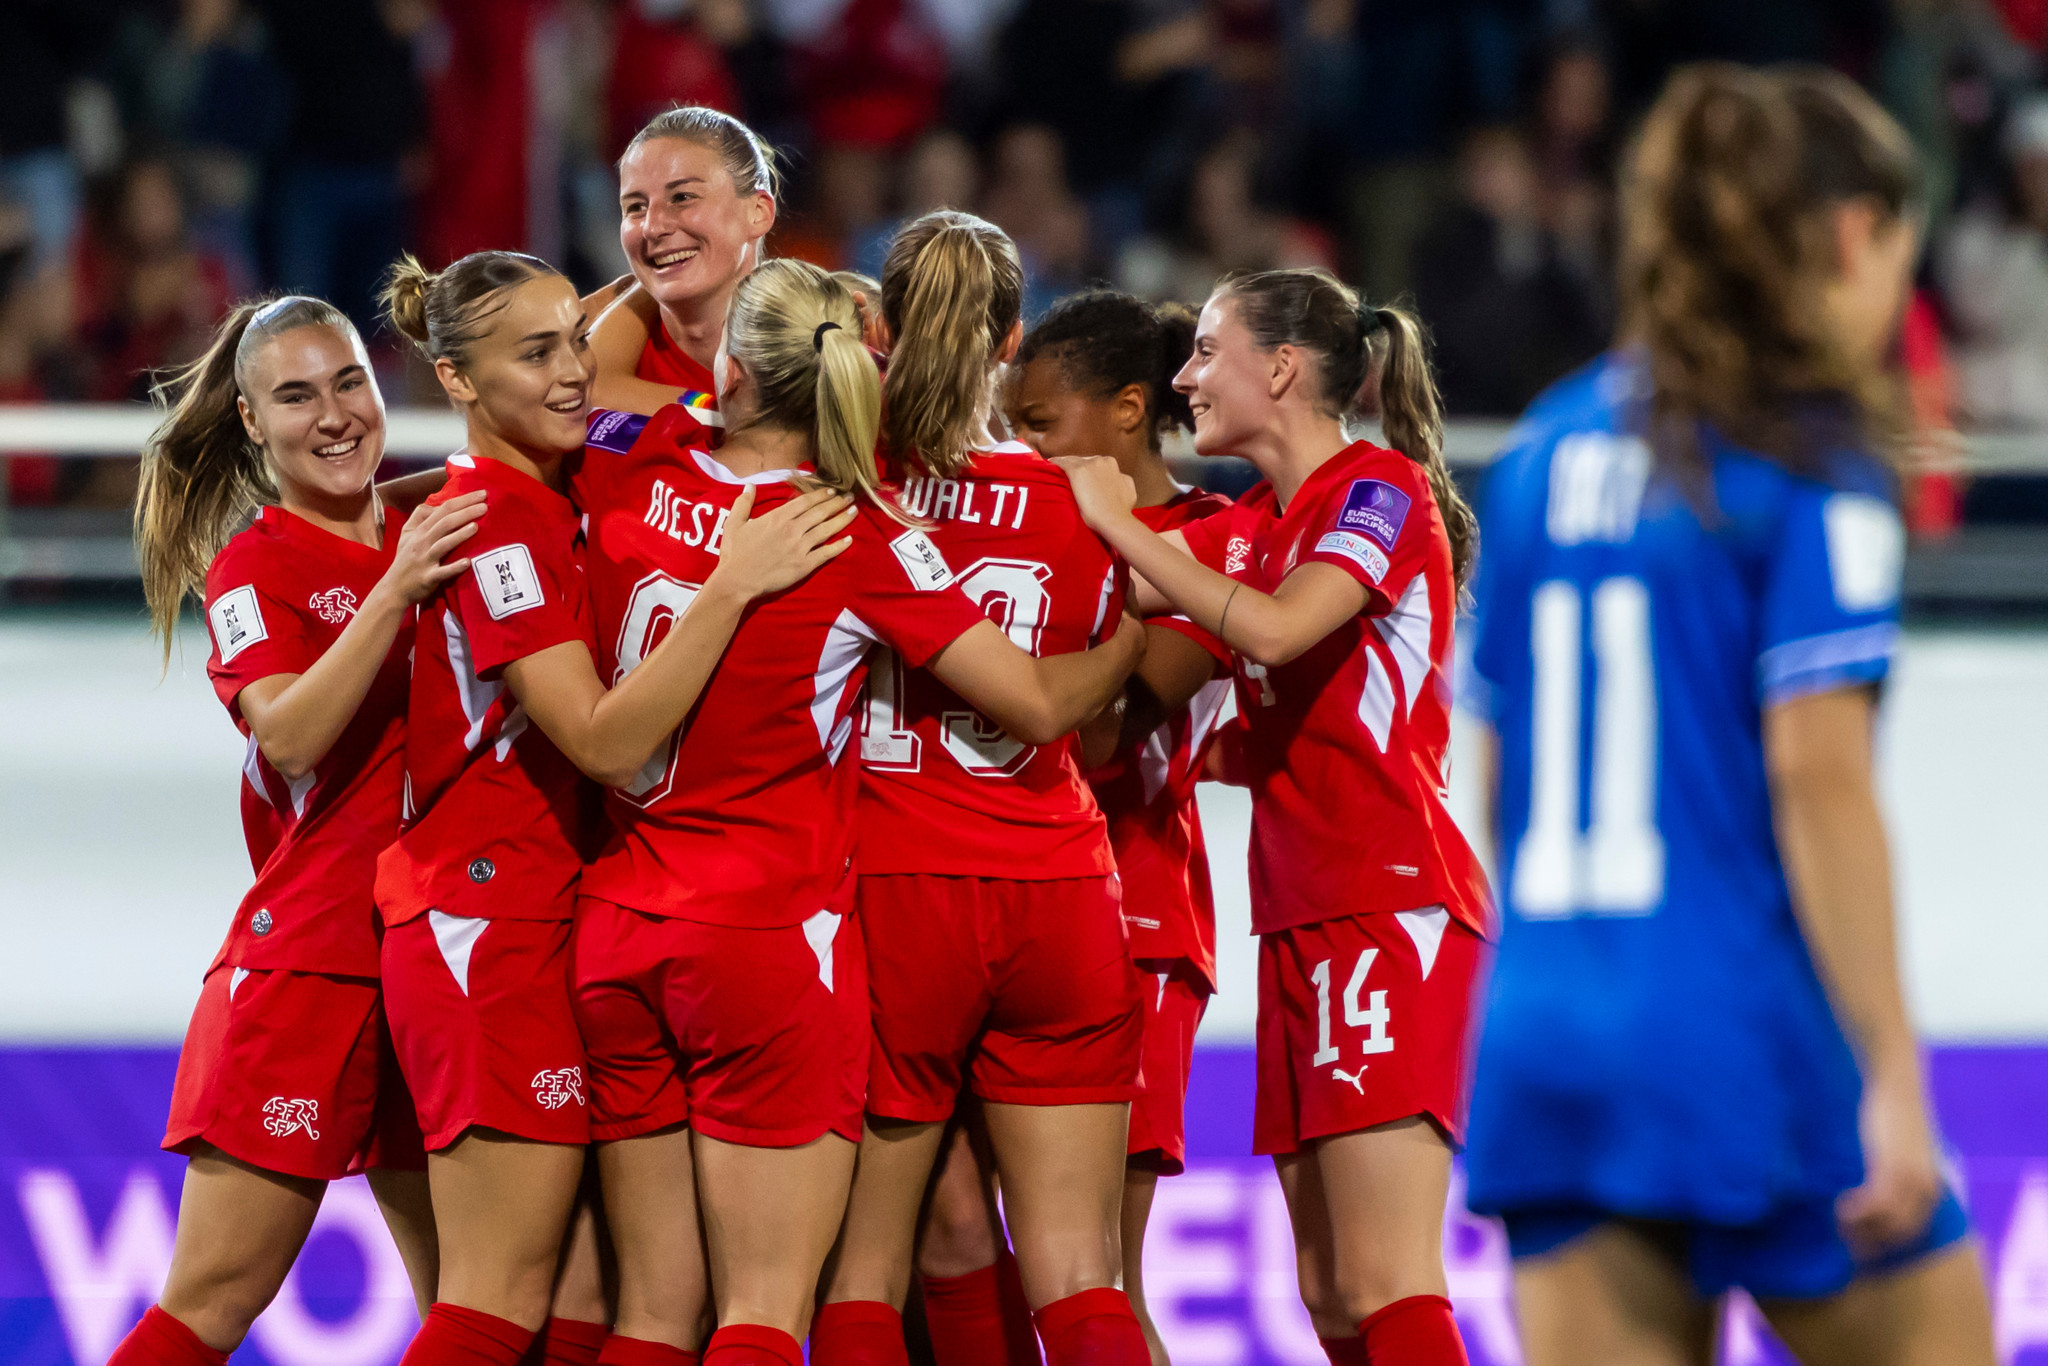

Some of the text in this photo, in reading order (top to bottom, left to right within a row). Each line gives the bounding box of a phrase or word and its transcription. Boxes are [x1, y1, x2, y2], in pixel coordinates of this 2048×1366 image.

[1343, 516, 1392, 542] QUALIFIERS
[1347, 509, 1395, 534] EUROPEAN
[1319, 536, 1386, 577] FOUNDATION
[1511, 574, 1668, 920] 11
[1310, 948, 1395, 1067] 14
